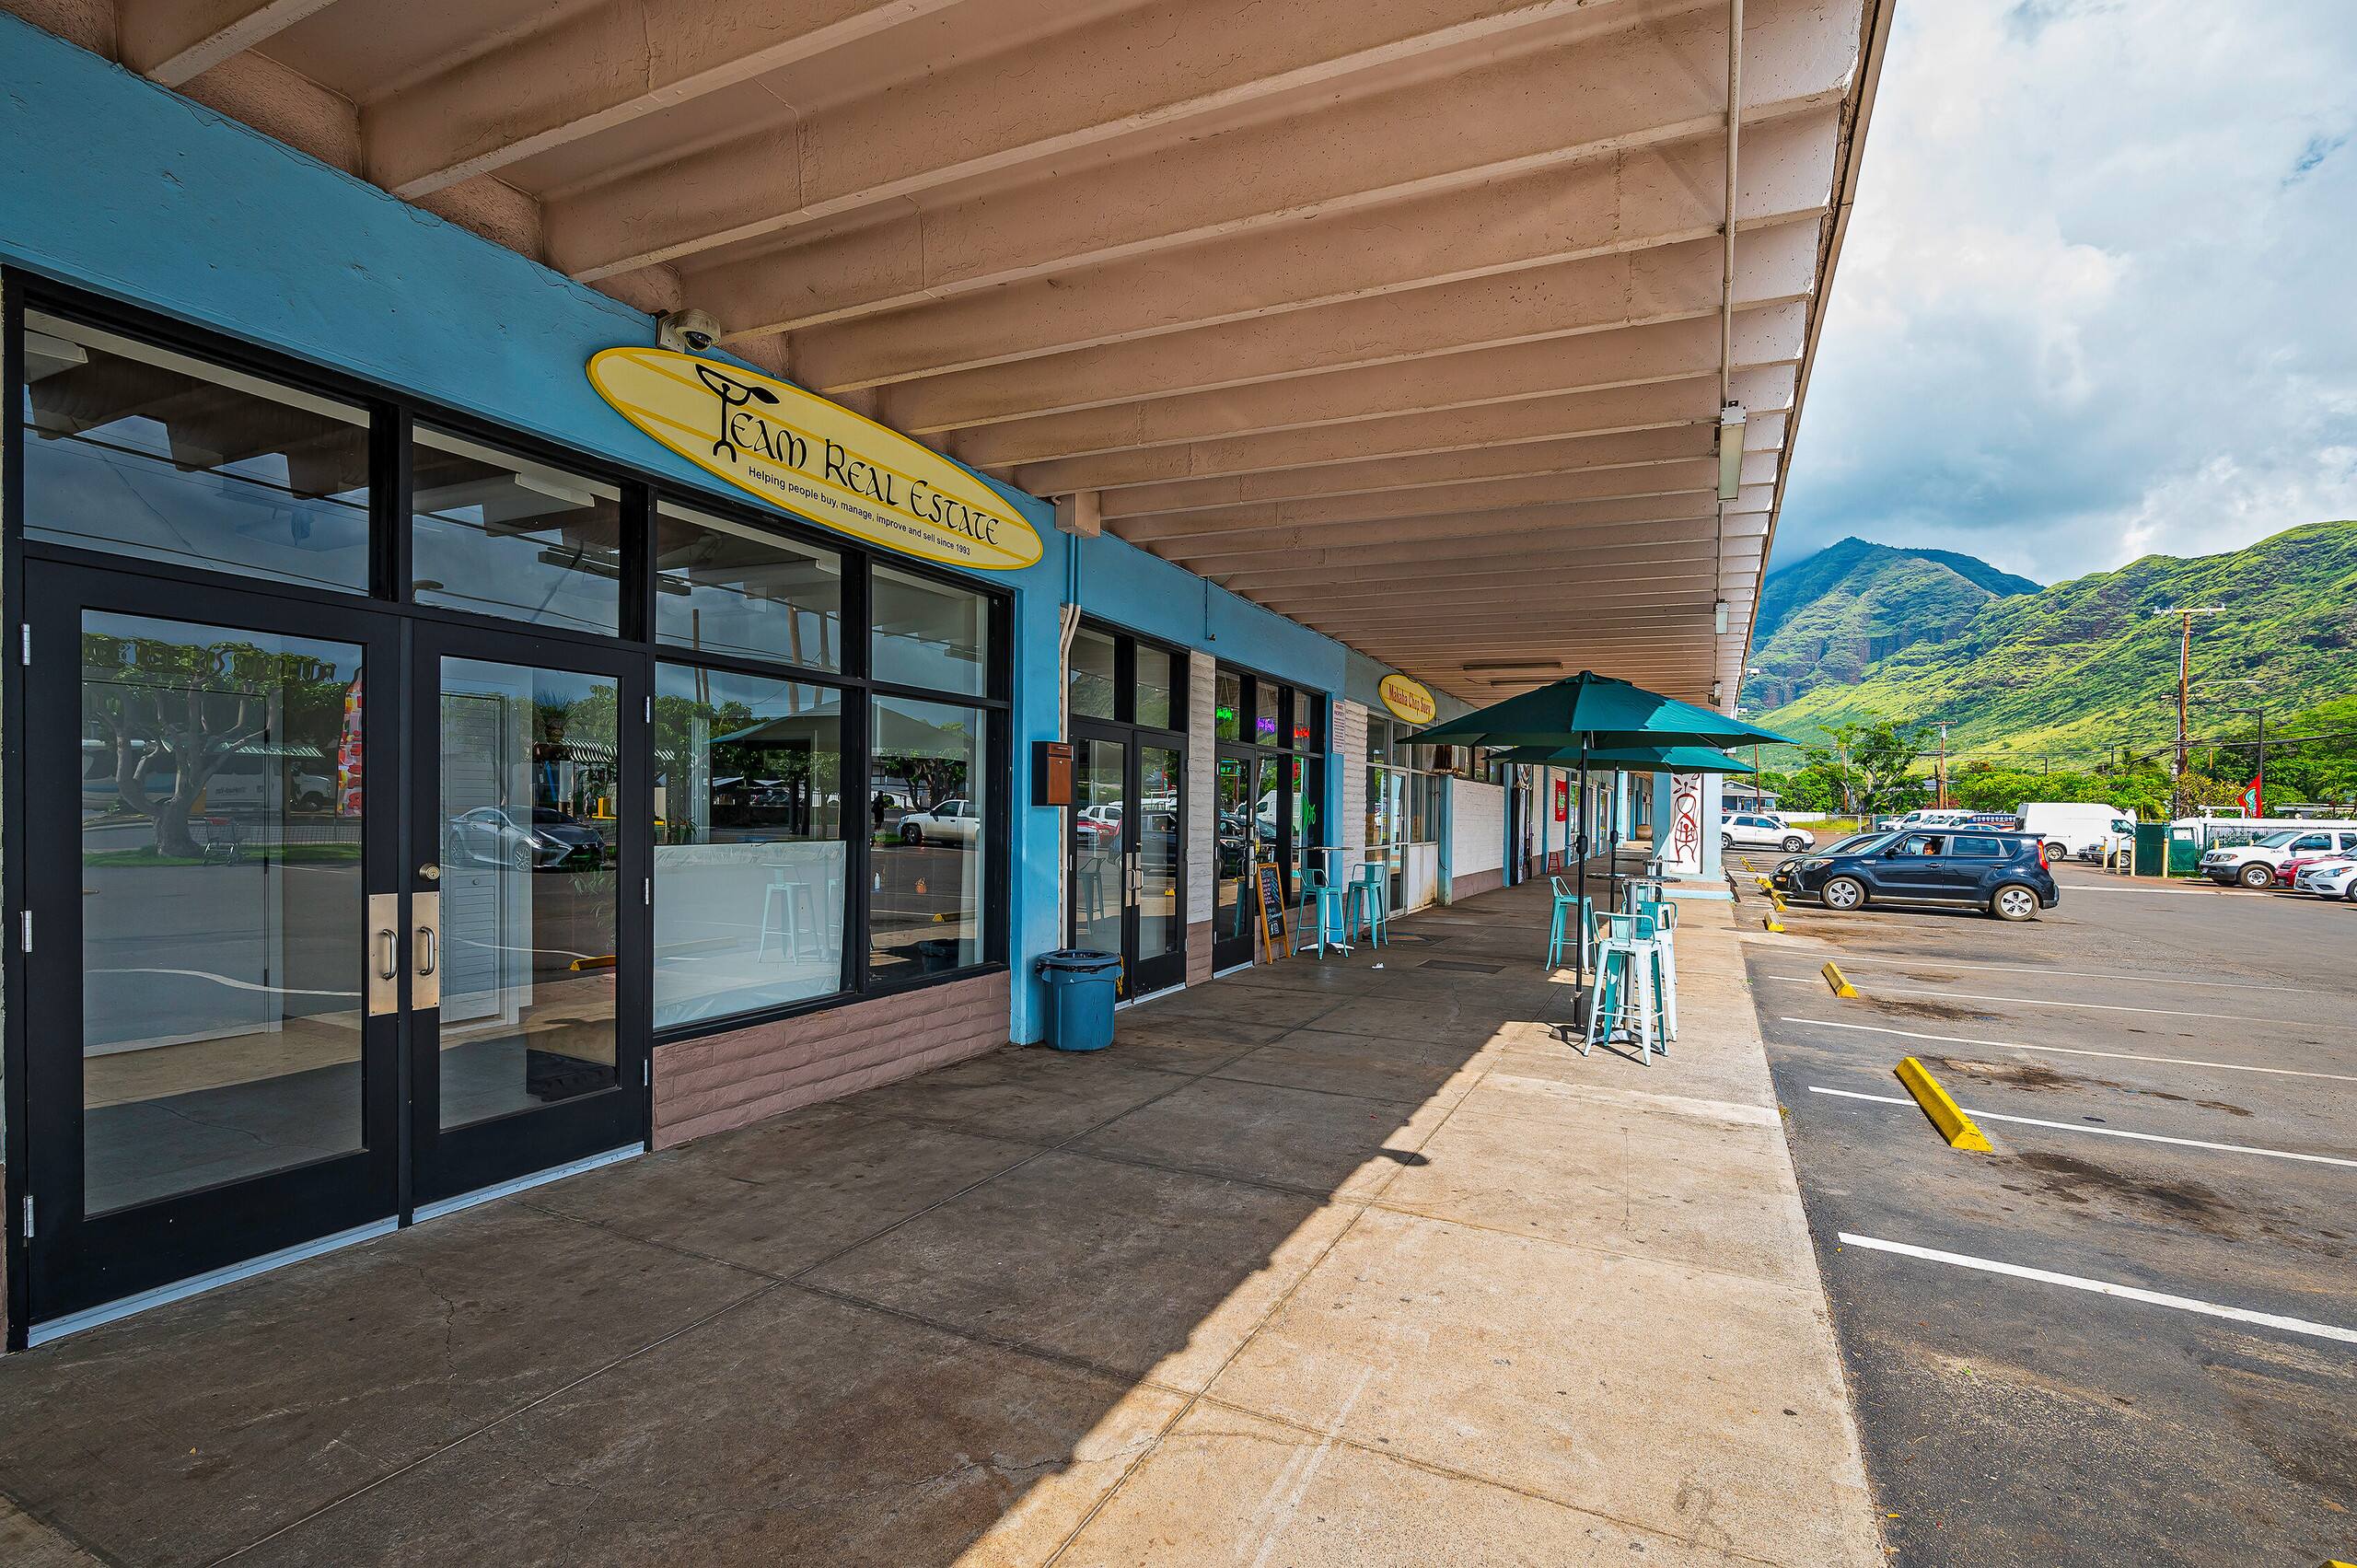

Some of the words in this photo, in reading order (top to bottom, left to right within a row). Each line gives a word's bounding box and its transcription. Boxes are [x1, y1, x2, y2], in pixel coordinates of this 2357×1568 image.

[749, 466, 785, 491] Helping
[788, 482, 819, 500] people
[820, 493, 839, 509] buy,
[841, 503, 875, 522] manage,
[876, 511, 907, 532] improve
[908, 525, 922, 538] and
[923, 531, 935, 543] sell
[936, 537, 955, 550] since
[956, 543, 970, 556] 1993
[825, 438, 899, 506] REAL
[910, 480, 1000, 545] ESTATE
[1388, 683, 1408, 706] Makaha
[1408, 691, 1420, 716] Chop
